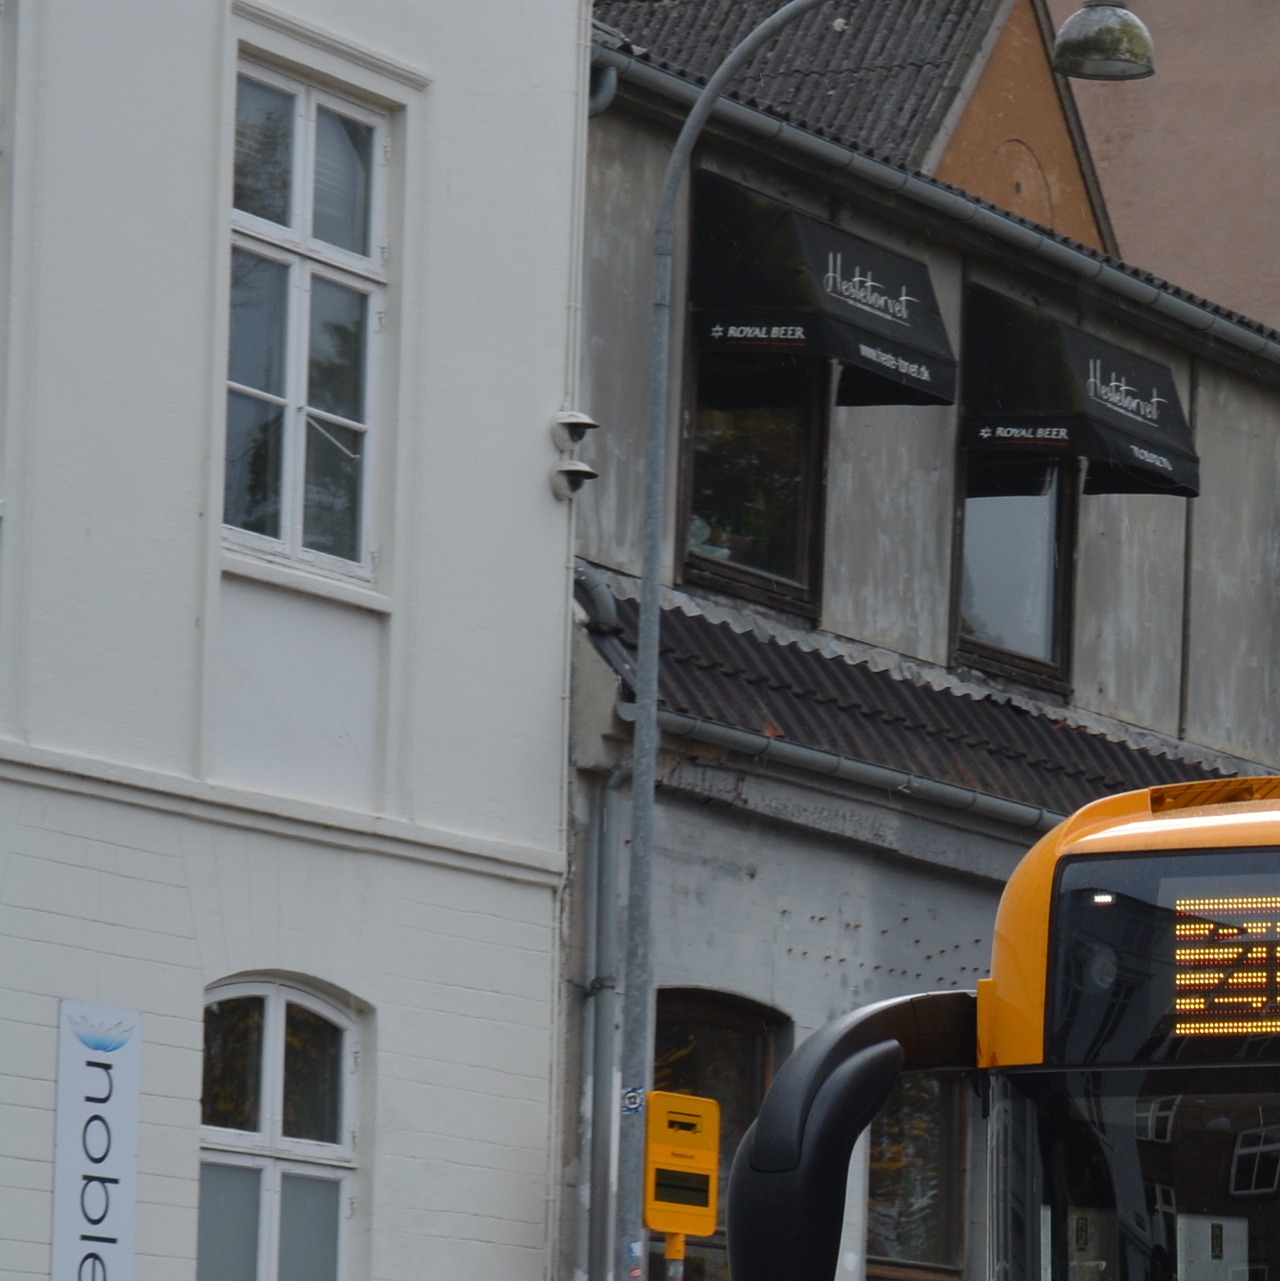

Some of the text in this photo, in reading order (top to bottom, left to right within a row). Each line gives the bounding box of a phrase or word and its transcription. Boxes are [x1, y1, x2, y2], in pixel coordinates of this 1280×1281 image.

[823, 251, 920, 319] Hestetorvet
[727, 325, 806, 339] ROYAL BEER
[995, 426, 1068, 439] ROYAL BEER
